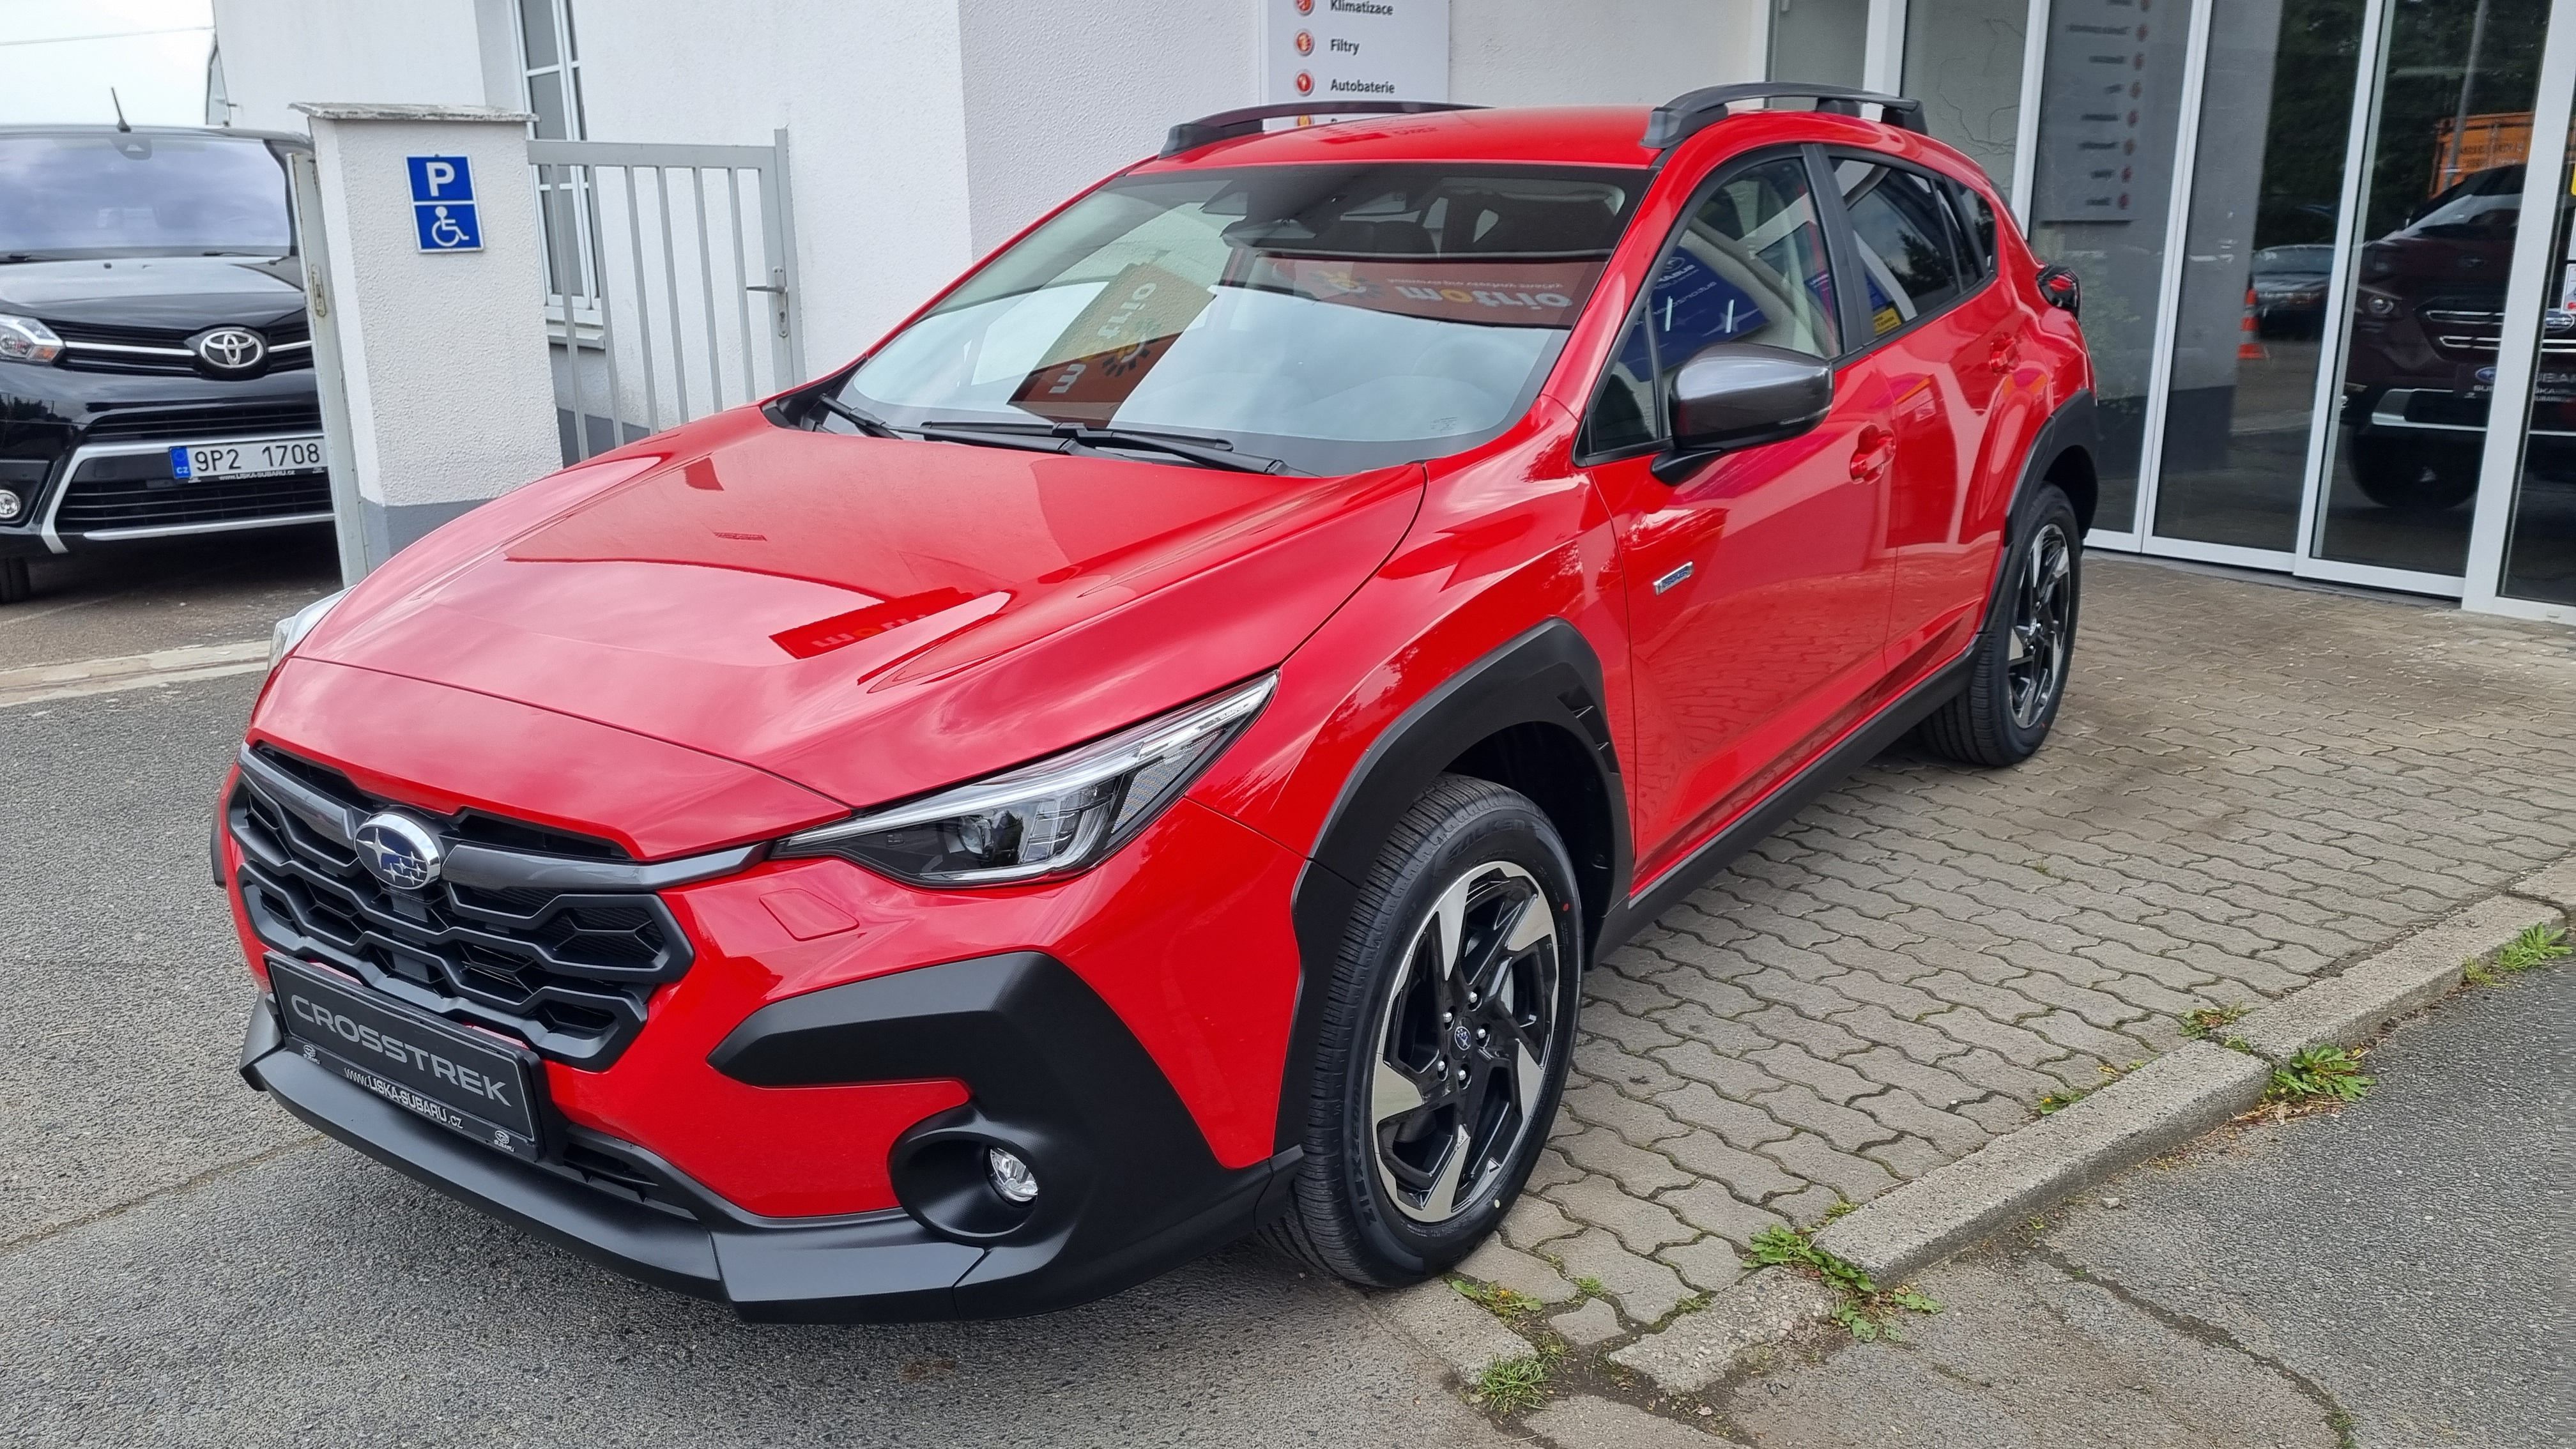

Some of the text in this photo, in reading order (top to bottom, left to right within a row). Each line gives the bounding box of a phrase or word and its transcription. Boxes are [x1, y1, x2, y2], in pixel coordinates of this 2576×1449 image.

[1331, 0, 1393, 15] Klimatizace
[1331, 39, 1360, 55] Filtry
[1331, 79, 1395, 94] Autobaterie
[426, 162, 455, 197] P
[194, 443, 319, 471] 9P2 1708
[291, 995, 511, 1107] CROSSTREK
